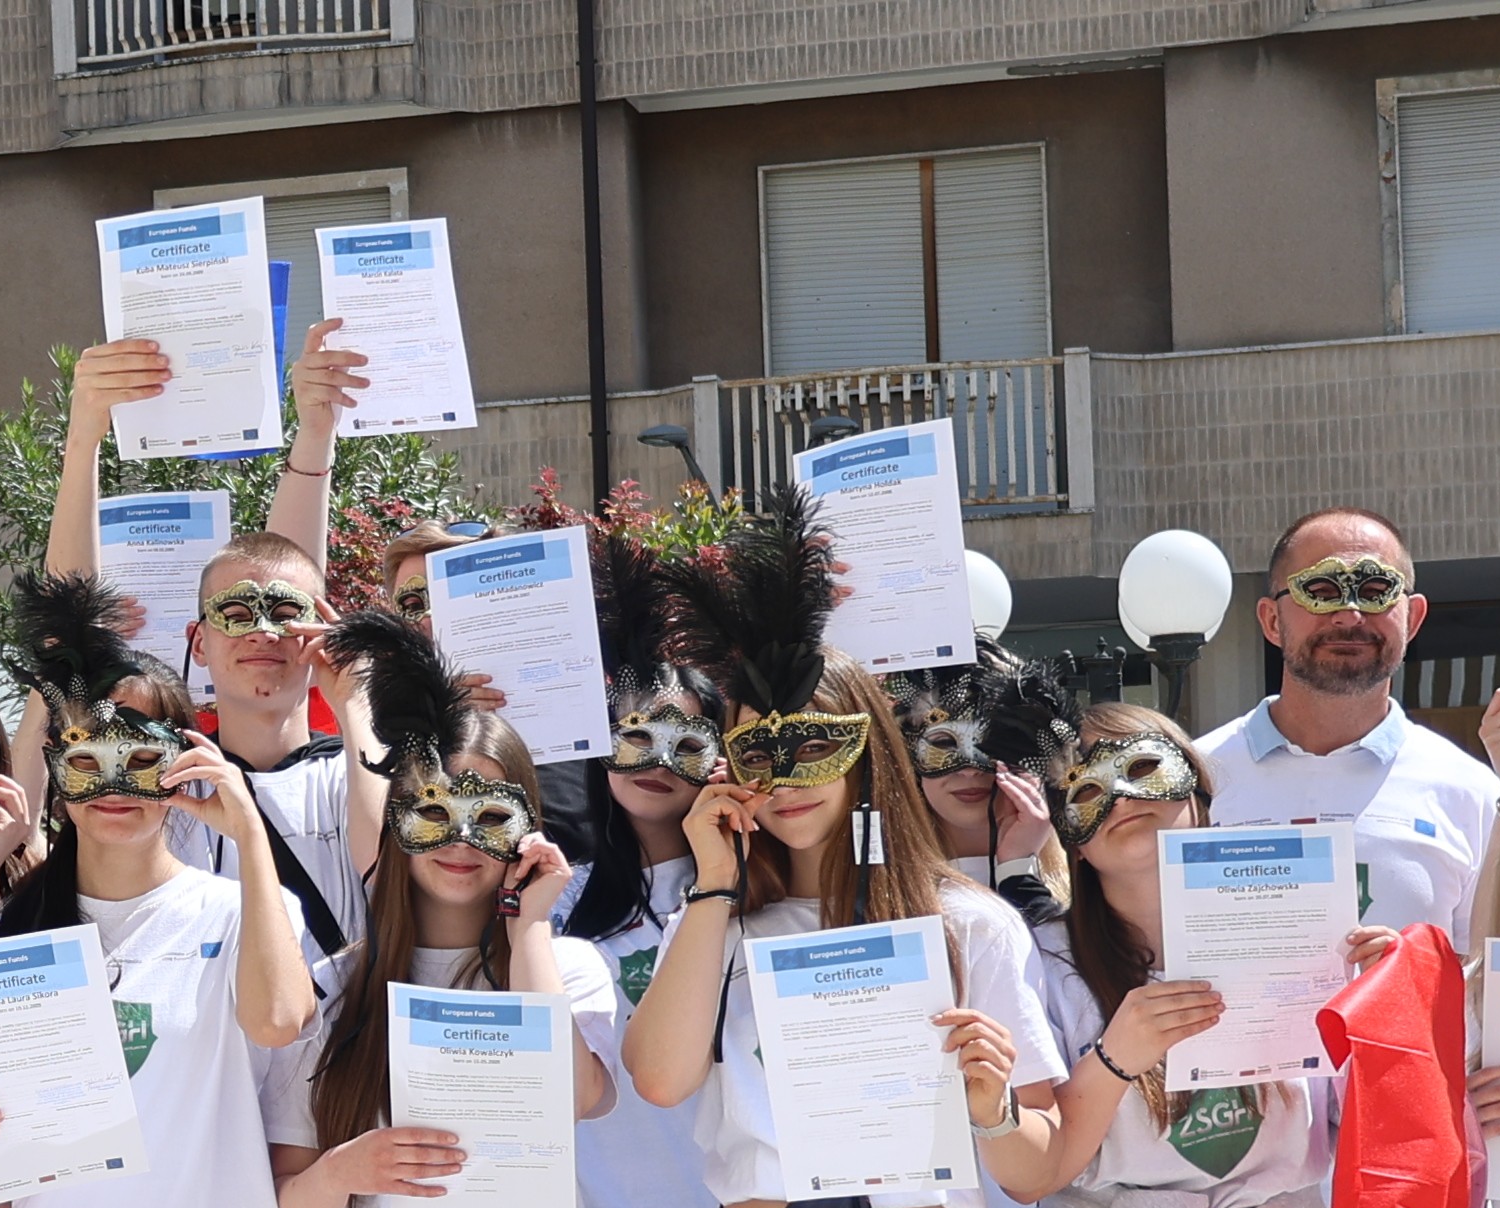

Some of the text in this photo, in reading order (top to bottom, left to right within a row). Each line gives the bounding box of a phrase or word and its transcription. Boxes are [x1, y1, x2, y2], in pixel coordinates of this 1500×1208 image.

[149, 228, 177, 237] European
[151, 242, 211, 258] Certificate
[136, 257, 229, 275] Kuba Mateusz Sierpiński
[358, 256, 404, 266] Certificate
[840, 452, 866, 462] European
[841, 464, 899, 481] Certificate
[840, 485, 873, 495] Martyna
[129, 525, 181, 534] Certificate
[475, 555, 503, 565] European
[479, 567, 535, 583] Certificate
[475, 589, 495, 598] Laura
[1223, 865, 1291, 877] Certificate
[1217, 883, 1299, 894] Oliwia Zajchowska
[810, 947, 866, 960] European Funds
[8, 955, 28, 964] Funds
[815, 967, 883, 983] Certificate
[7, 995, 31, 1003] Laura
[32, 991, 58, 1001] Sikora
[813, 985, 891, 1000] Myroslava Syrota
[442, 1009, 473, 1017] European
[444, 1029, 510, 1041] Certificate
[440, 1047, 514, 1058] Oliwia Kowalczyk
